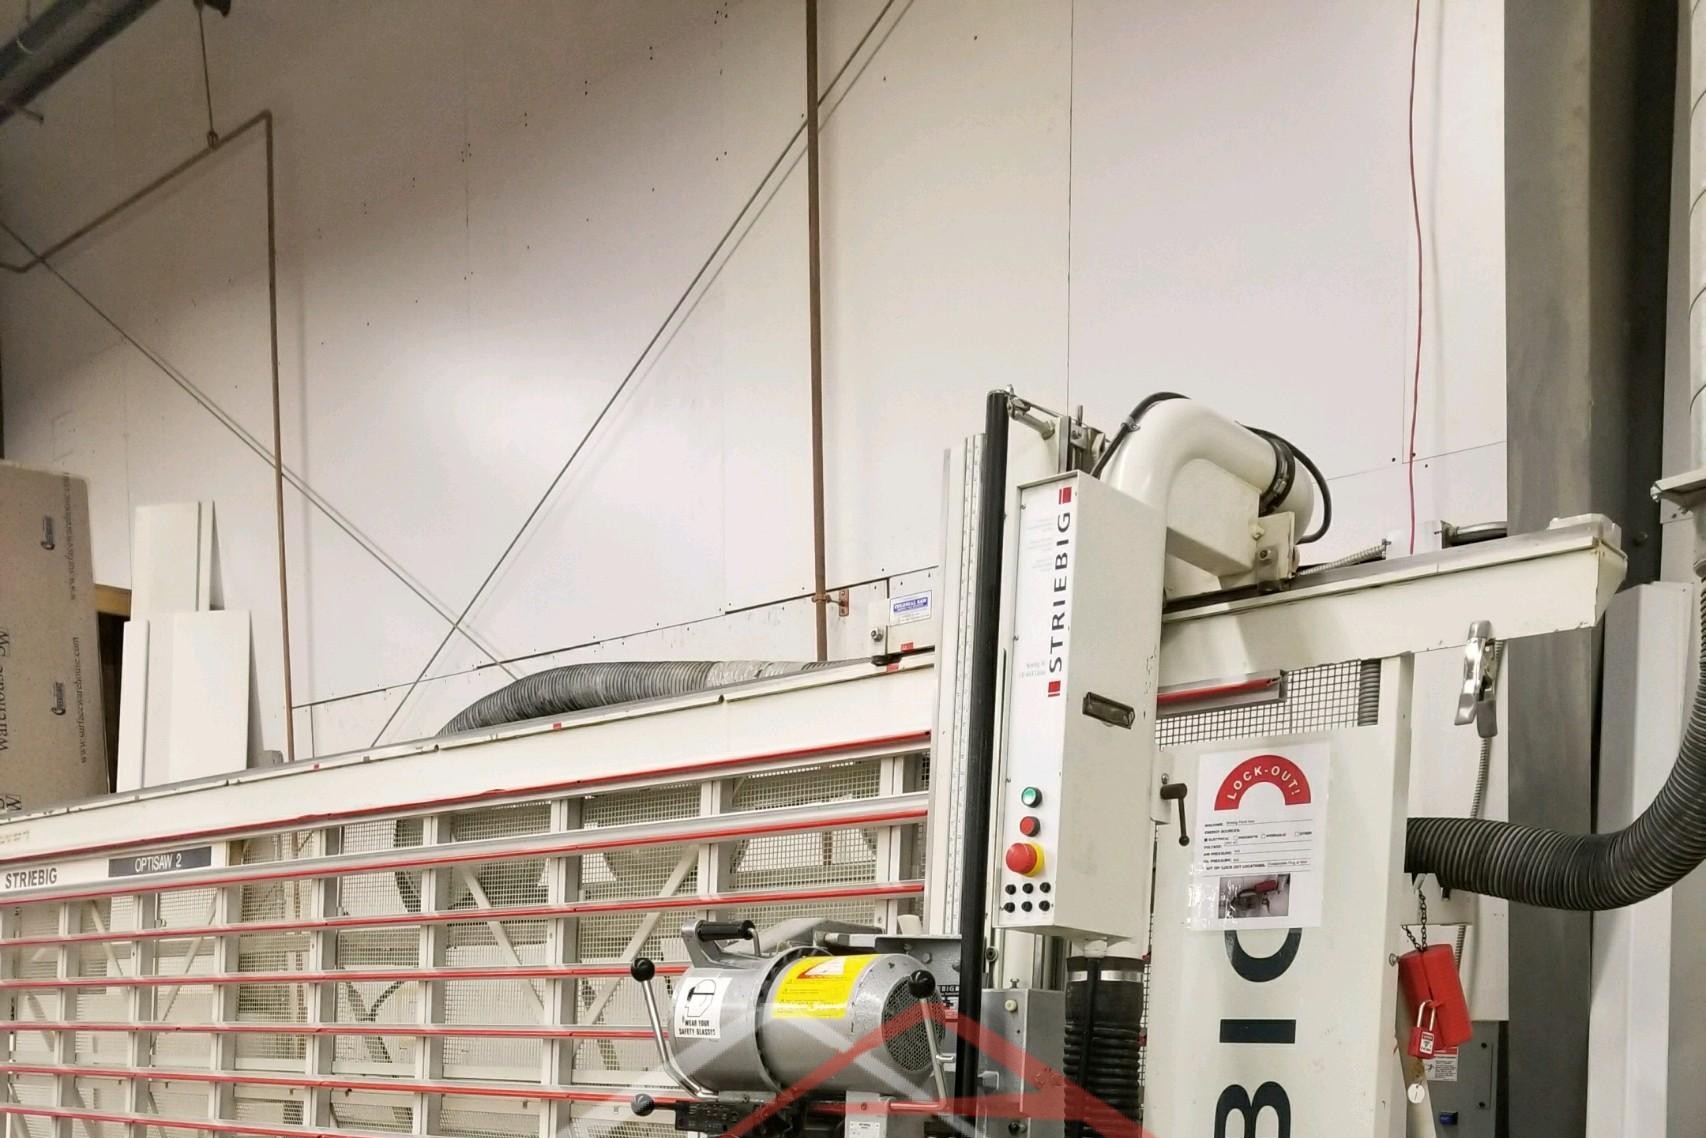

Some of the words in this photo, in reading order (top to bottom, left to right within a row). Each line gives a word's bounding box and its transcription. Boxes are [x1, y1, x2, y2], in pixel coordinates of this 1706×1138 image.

[1048, 512, 1071, 673] STRIEBIG
[1227, 765, 1302, 800] LOCK-OUT!
[135, 855, 172, 873] OPTISAW
[176, 853, 182, 868] 2
[5, 868, 57, 889] STRIEBIG
[698, 1019, 709, 1027] YOUR
